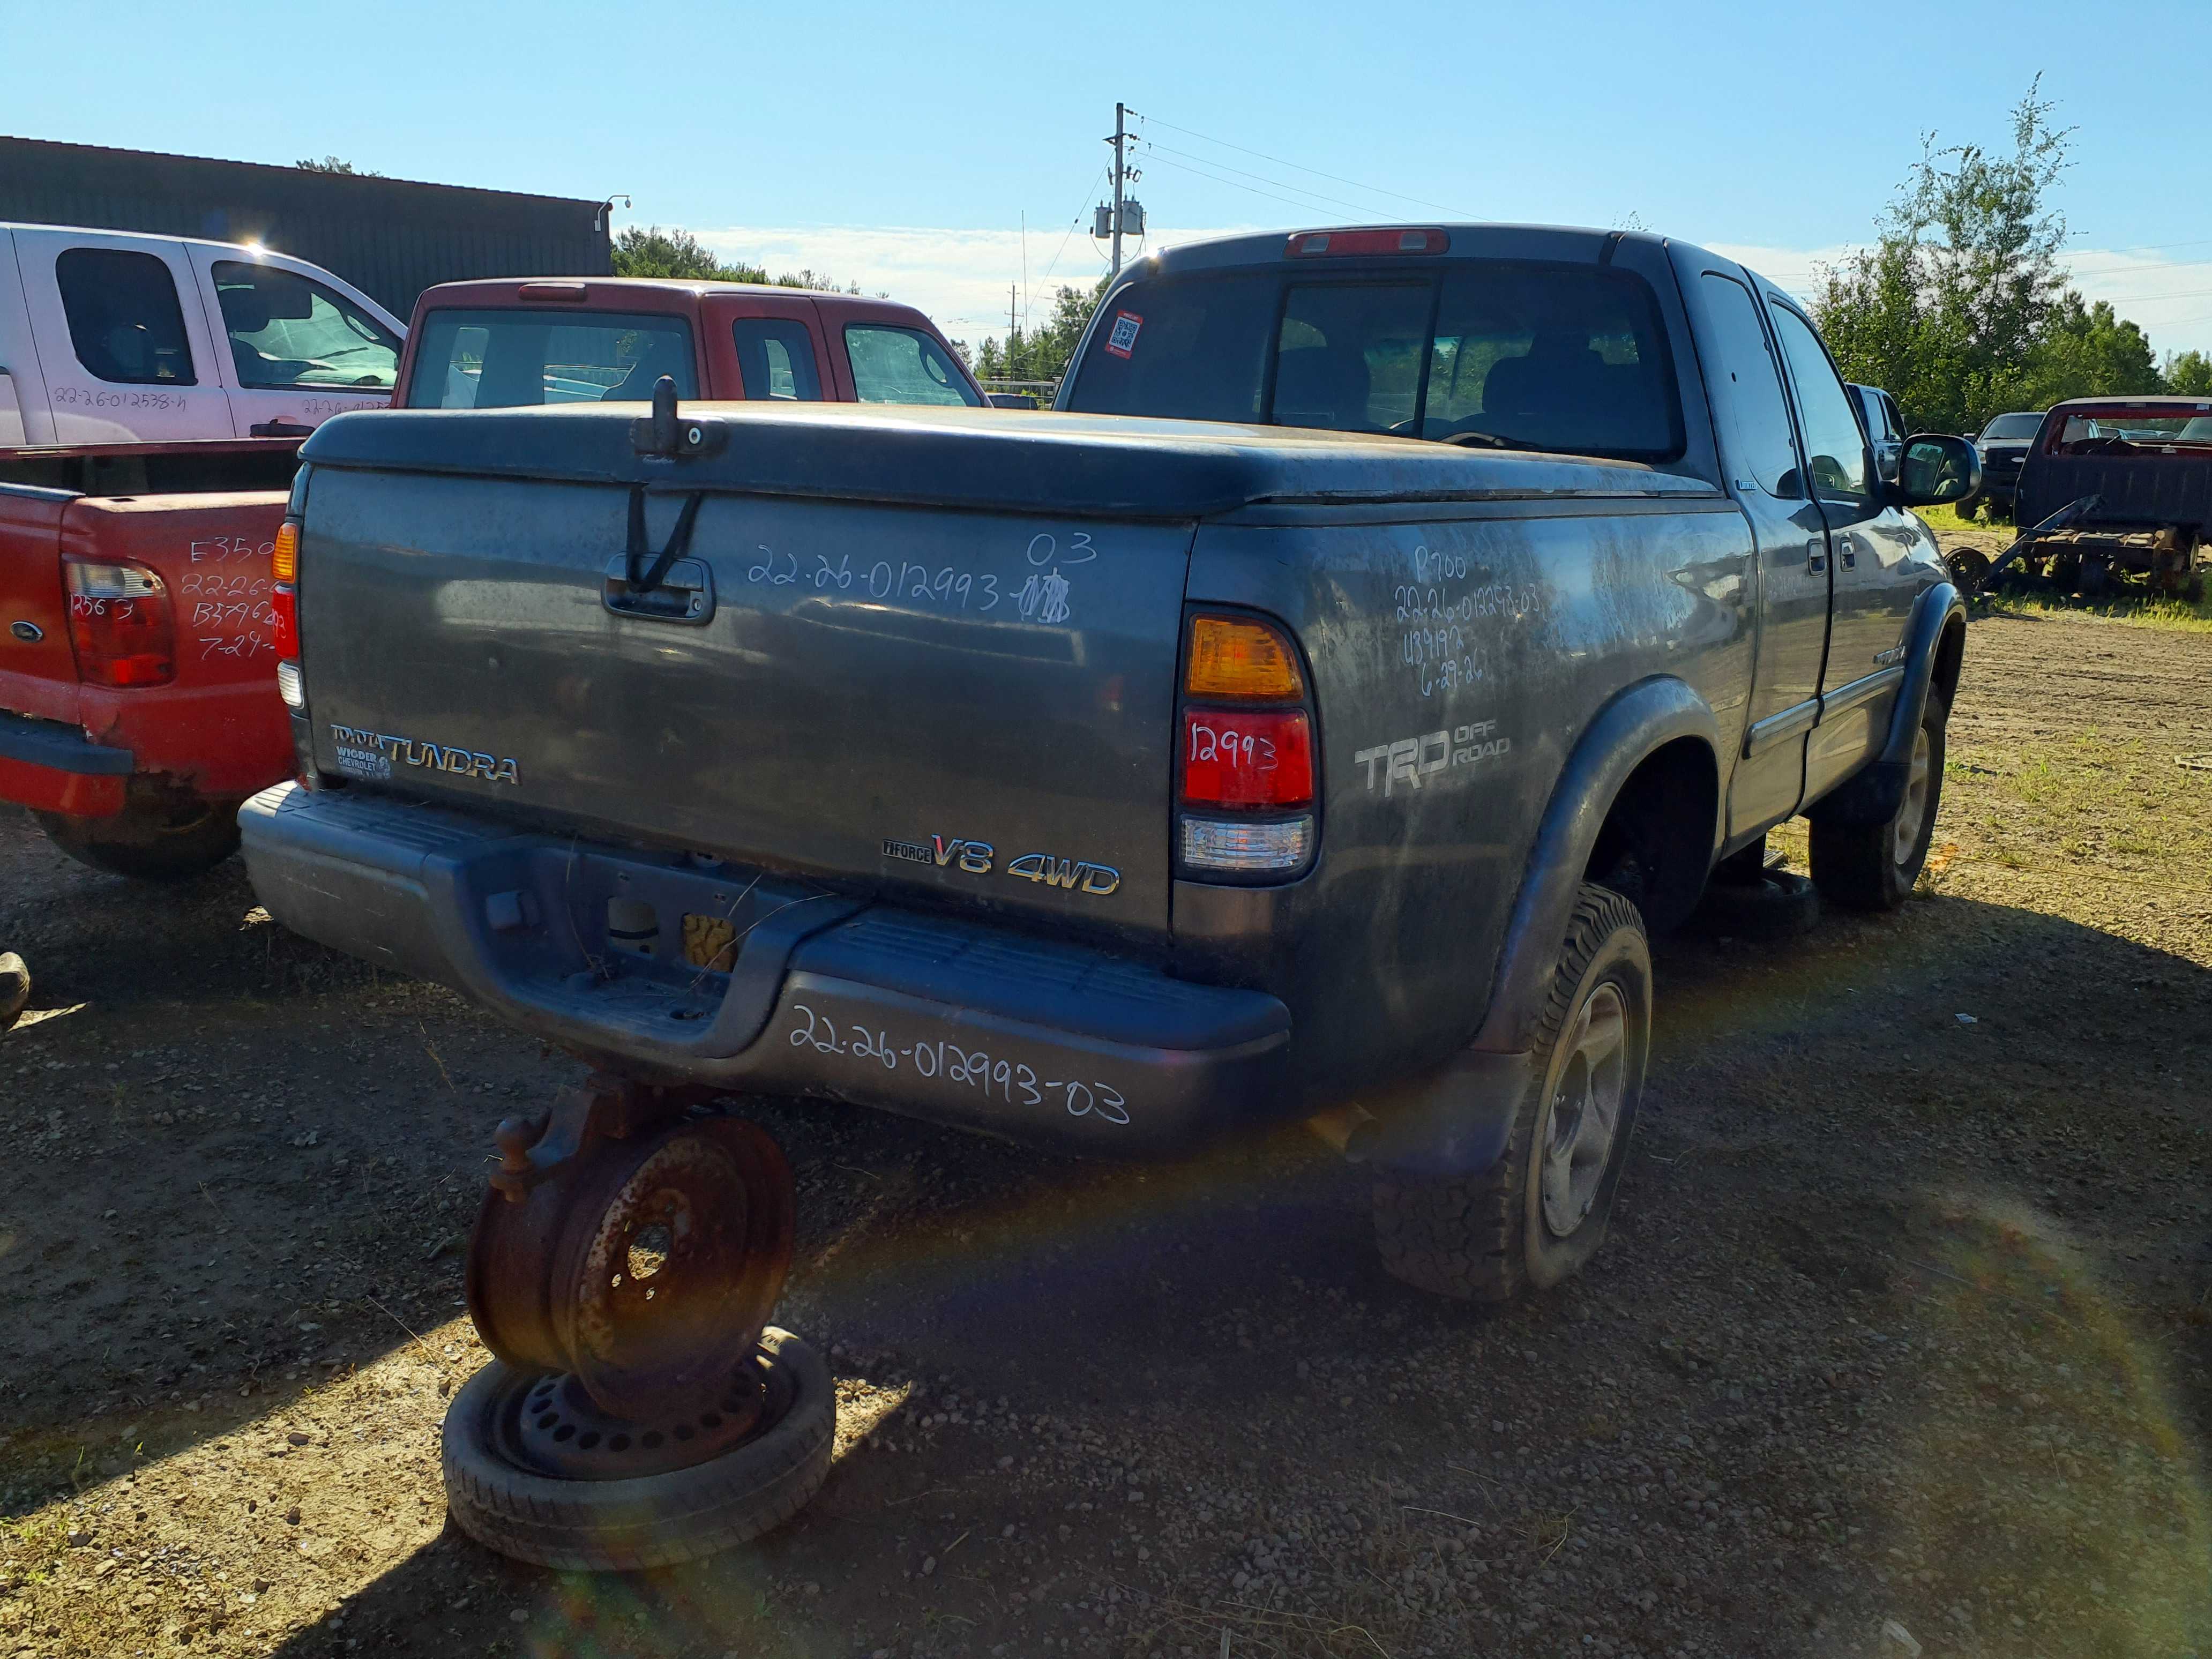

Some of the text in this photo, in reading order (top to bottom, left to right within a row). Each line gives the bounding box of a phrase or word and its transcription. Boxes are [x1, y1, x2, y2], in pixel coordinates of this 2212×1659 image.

[1027, 532, 1097, 566] 03
[1191, 722, 1279, 771] 12993
[1454, 719, 1497, 744] OFF
[330, 724, 523, 786] TOYOTA TUNDRA
[335, 745, 377, 763] WIGDER
[338, 756, 376, 772] CHEVROLET
[1354, 730, 1450, 798] TRD
[1452, 737, 1511, 767] ROAD
[931, 833, 995, 873] V8
[1007, 854, 1120, 895] 4WD
